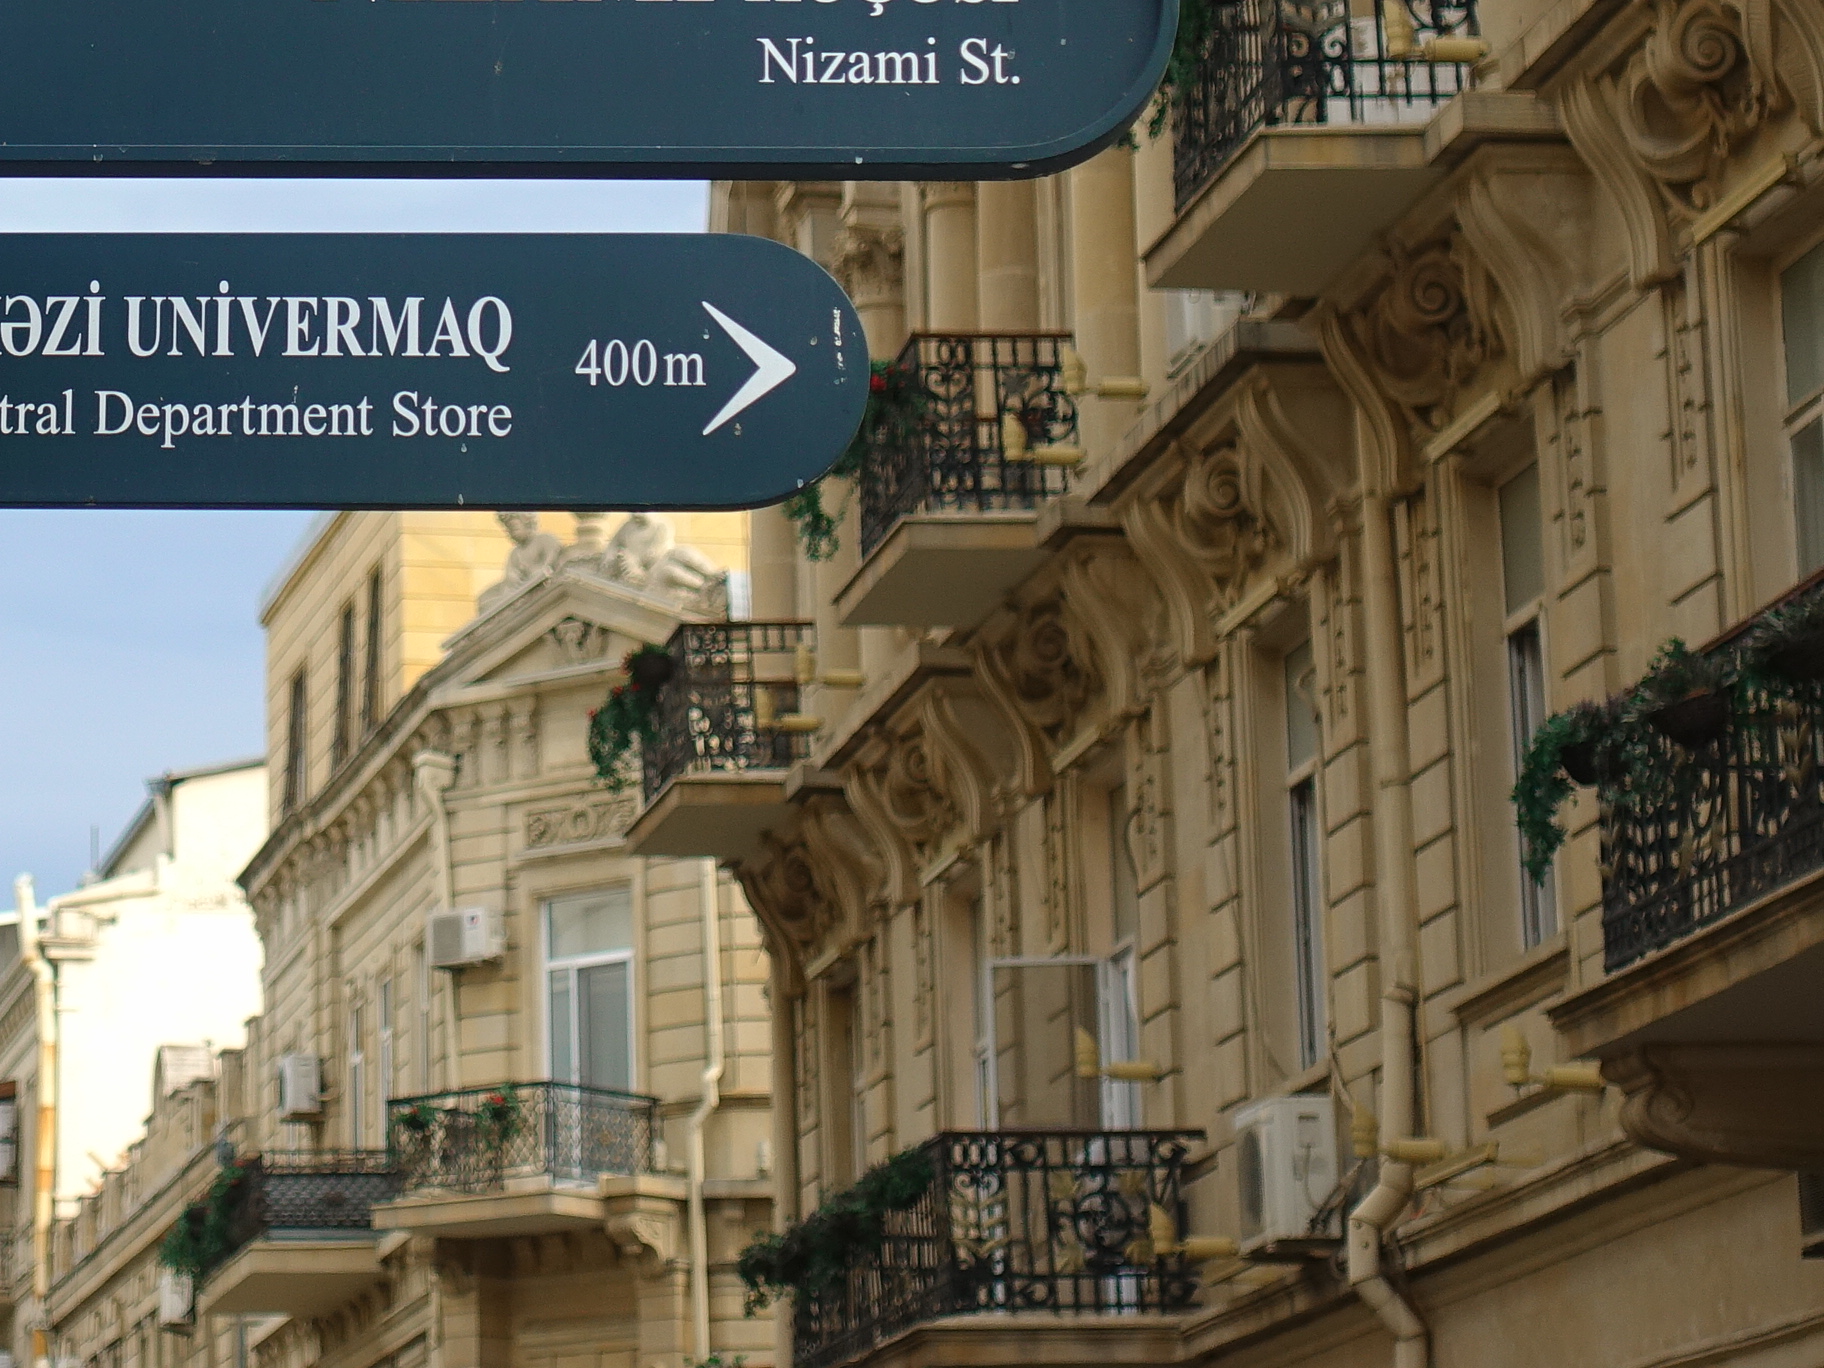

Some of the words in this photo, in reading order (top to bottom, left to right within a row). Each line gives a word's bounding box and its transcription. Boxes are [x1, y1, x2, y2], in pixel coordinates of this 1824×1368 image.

[756, 36, 941, 85] Nizami
[959, 36, 1021, 85] St.
[123, 279, 514, 374] UNİVERMAQ
[574, 338, 708, 388] 400m
[92, 389, 375, 450] Department
[391, 389, 514, 438] Store
